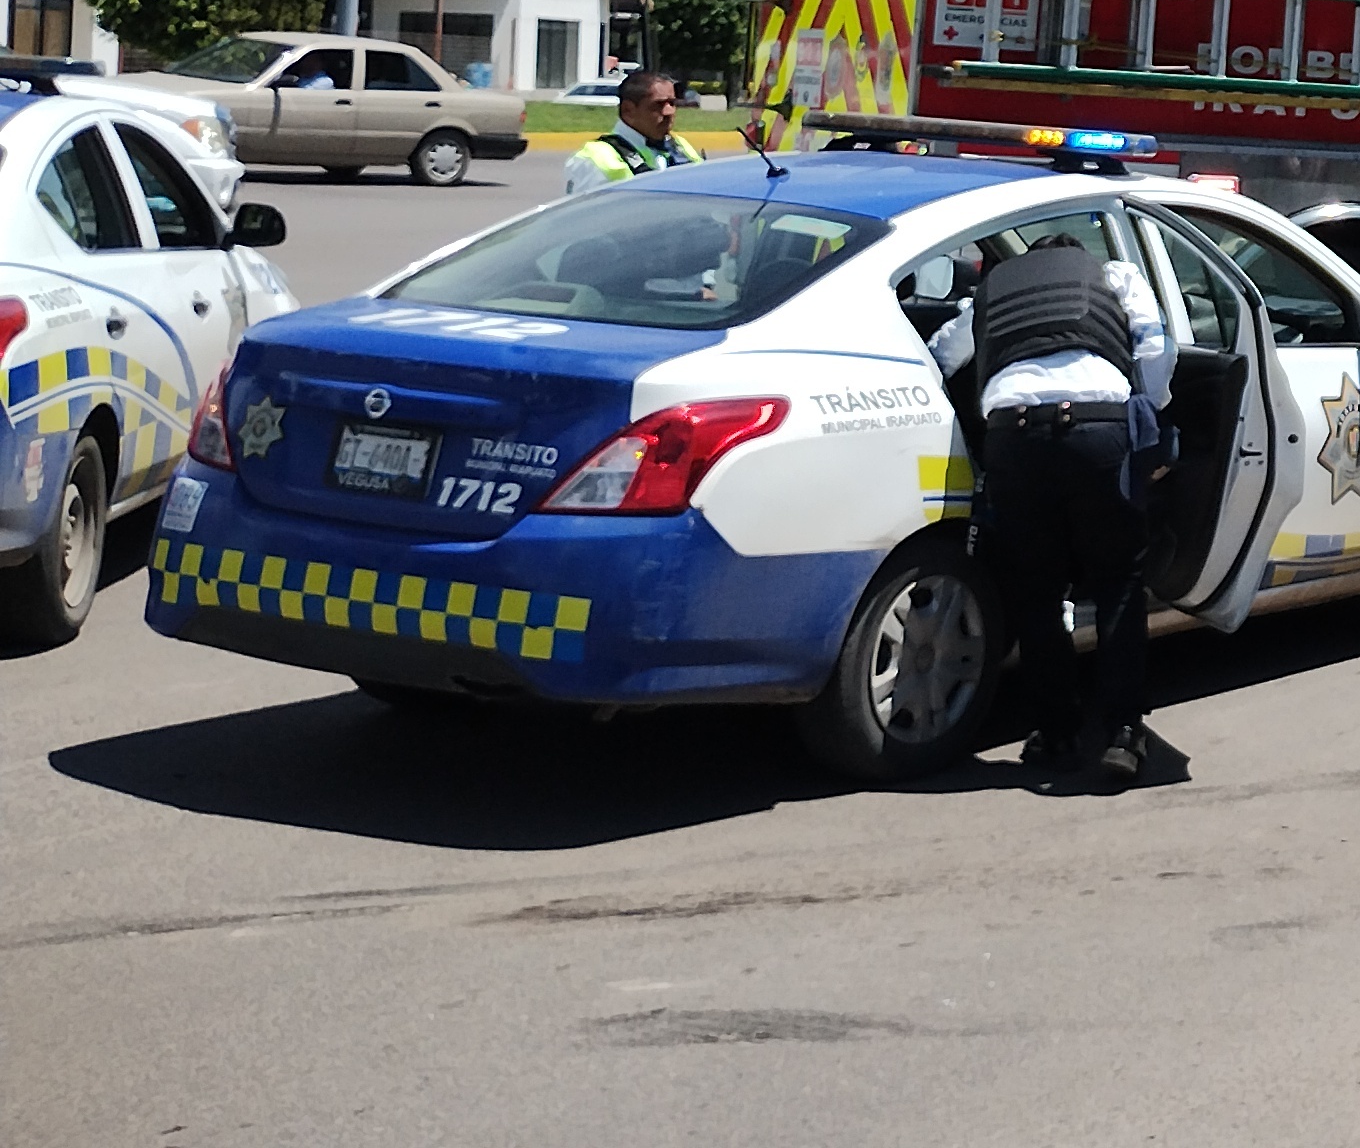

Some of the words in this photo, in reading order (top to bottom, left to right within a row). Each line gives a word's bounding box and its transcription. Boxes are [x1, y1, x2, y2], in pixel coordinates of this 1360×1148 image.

[944, 13, 1027, 27] EMERGCIAS
[348, 308, 569, 340] 1712
[809, 386, 930, 414] TRÁNSITO
[821, 417, 886, 434] MUNICIPAL
[886, 412, 942, 427] IRAPUATO
[437, 476, 522, 513] 1712
